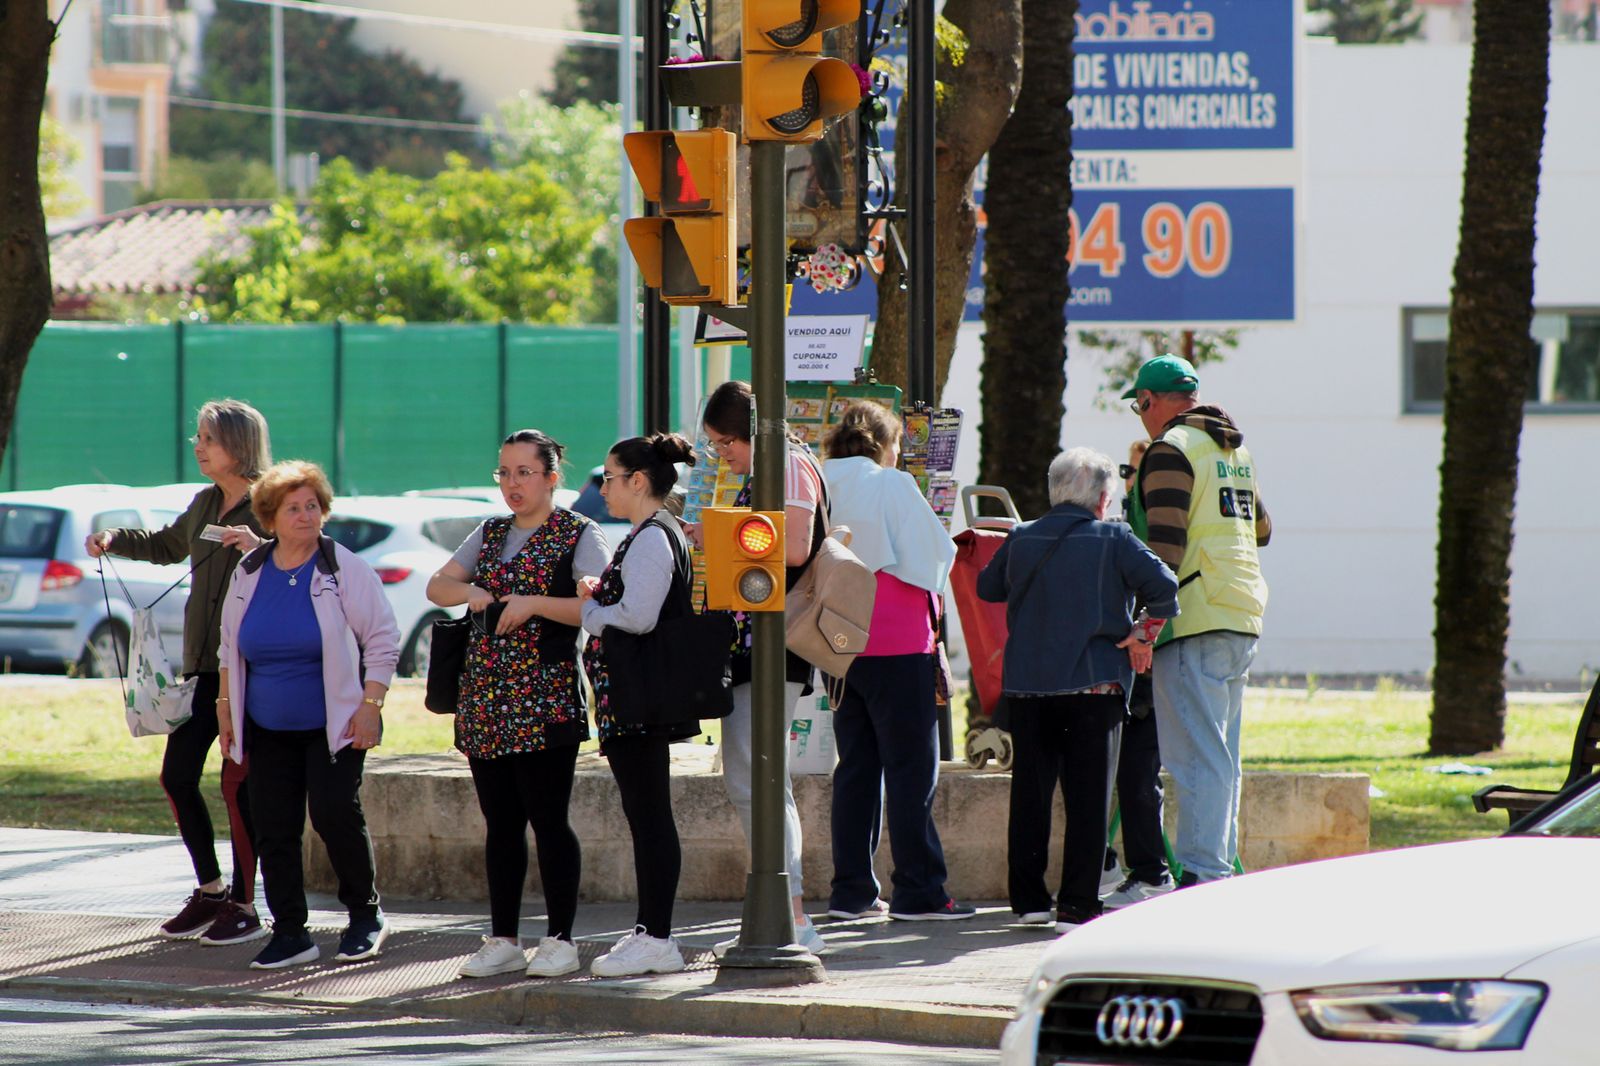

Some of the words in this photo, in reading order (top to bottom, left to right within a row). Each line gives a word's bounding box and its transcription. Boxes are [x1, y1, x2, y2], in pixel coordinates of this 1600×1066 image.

[1074, 53, 1107, 88] DE
[1113, 52, 1258, 90] VIVIENDAS,
[1143, 93, 1276, 129] COMERCIALES
[1142, 202, 1232, 278] 90
[829, 326, 852, 335] AQUÍ
[793, 352, 838, 360] CUPONAZO
